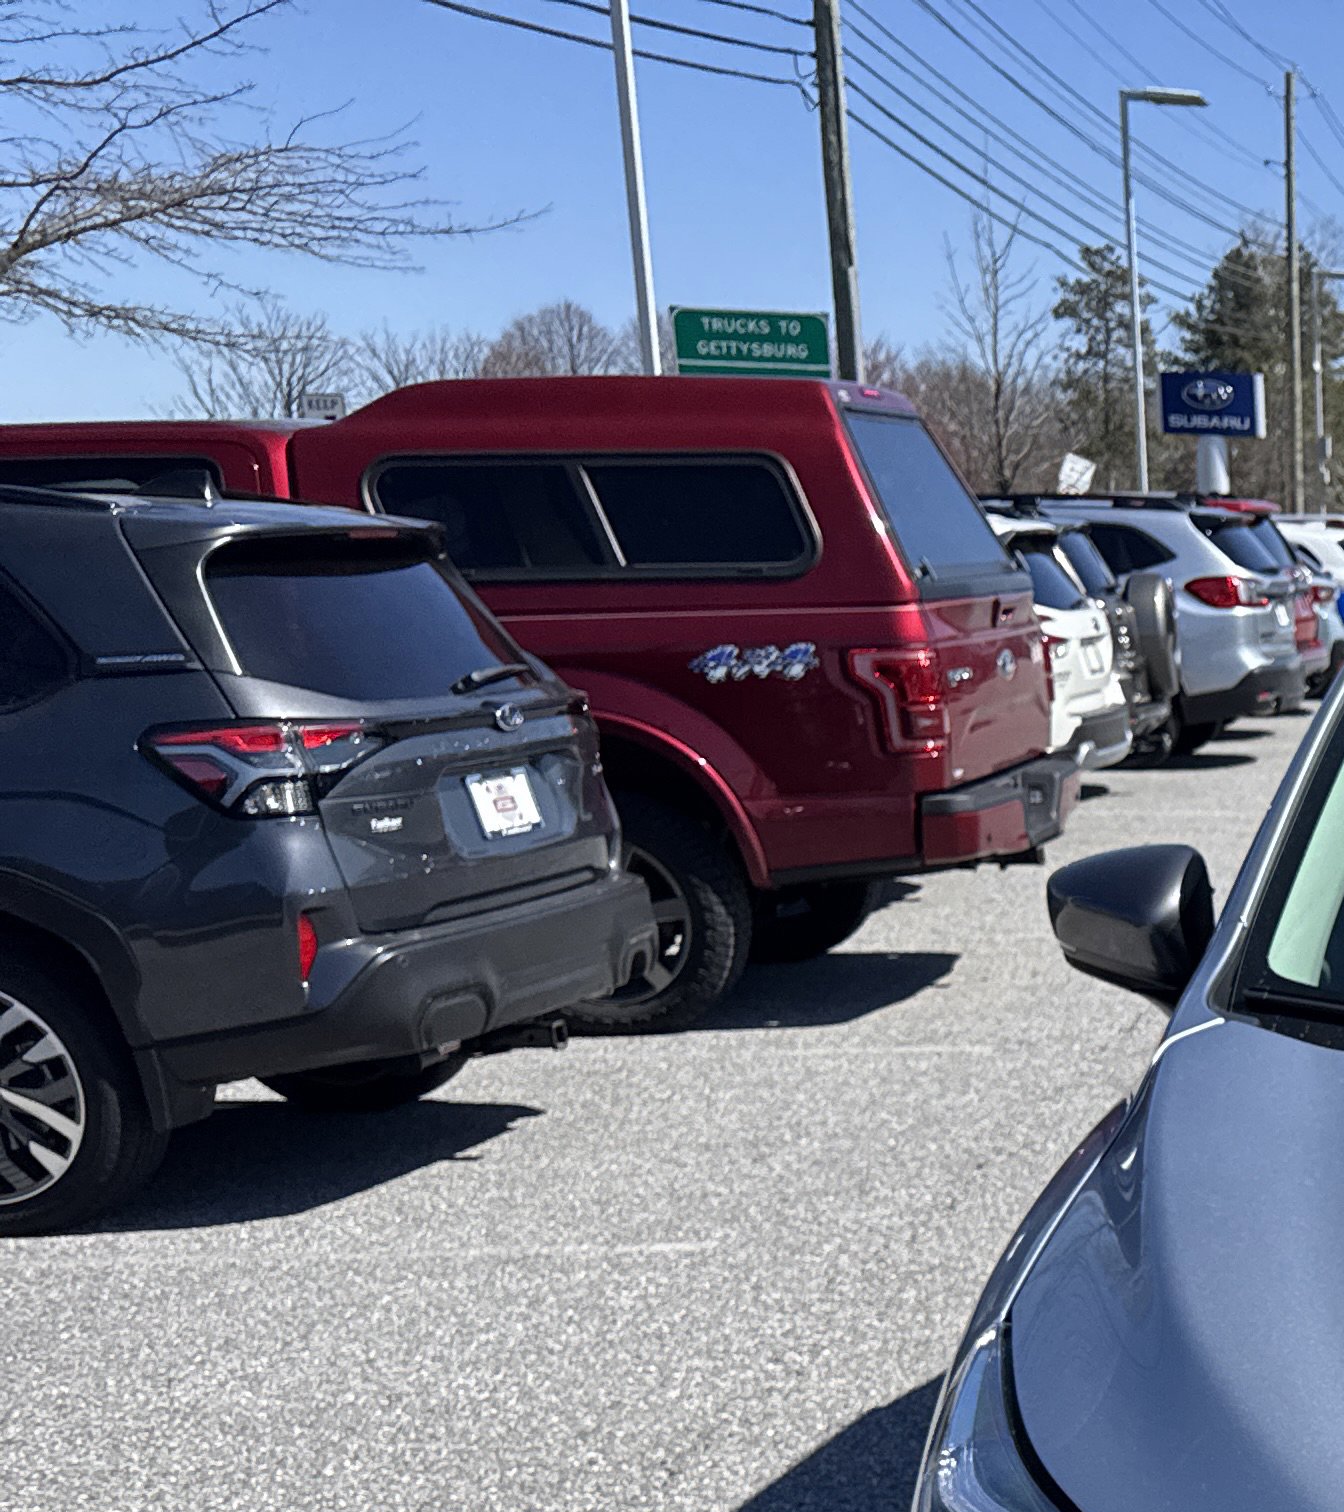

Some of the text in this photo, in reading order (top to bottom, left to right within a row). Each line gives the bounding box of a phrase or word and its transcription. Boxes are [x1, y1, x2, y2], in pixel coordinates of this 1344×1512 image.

[700, 316, 801, 336] TRUCKS TO
[696, 340, 809, 360] GETTYSBURG
[1168, 413, 1250, 431] SUBARU
